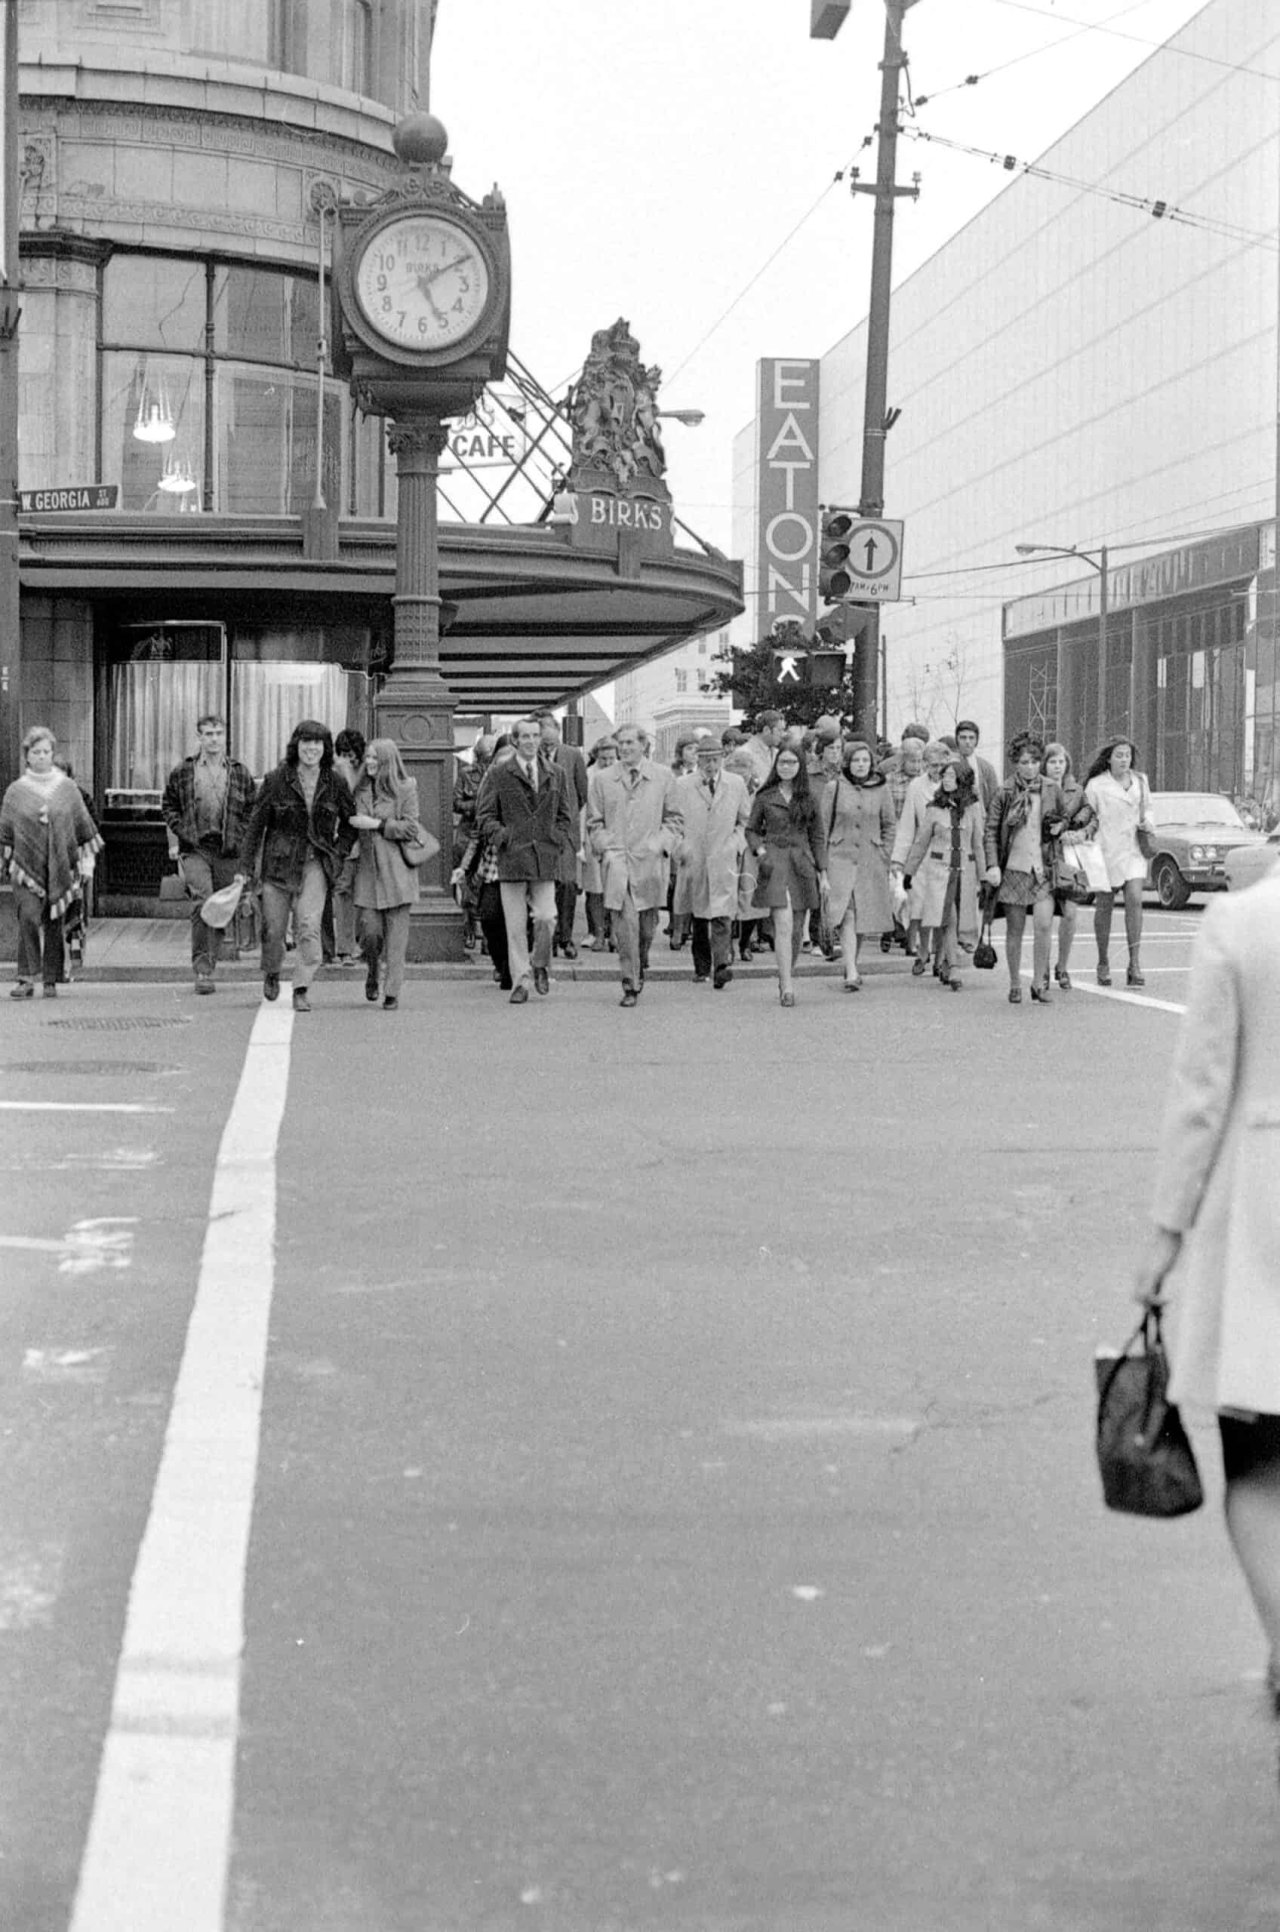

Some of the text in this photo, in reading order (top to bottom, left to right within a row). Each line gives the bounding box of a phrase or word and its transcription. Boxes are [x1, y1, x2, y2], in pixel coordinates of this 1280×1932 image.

[441, 241, 446, 257] 1
[379, 253, 395, 272] 10
[376, 274, 387, 291] 9
[459, 275, 469, 292] 3
[381, 295, 392, 312] 8
[450, 296, 463, 313] 4
[396, 310, 407, 327] 7
[417, 316, 427, 333] 6
[438, 311, 448, 328] 5
[452, 435, 515, 457] CAFE
[35, 490, 91, 510] GEORGIA
[590, 497, 662, 530] BIRKS
